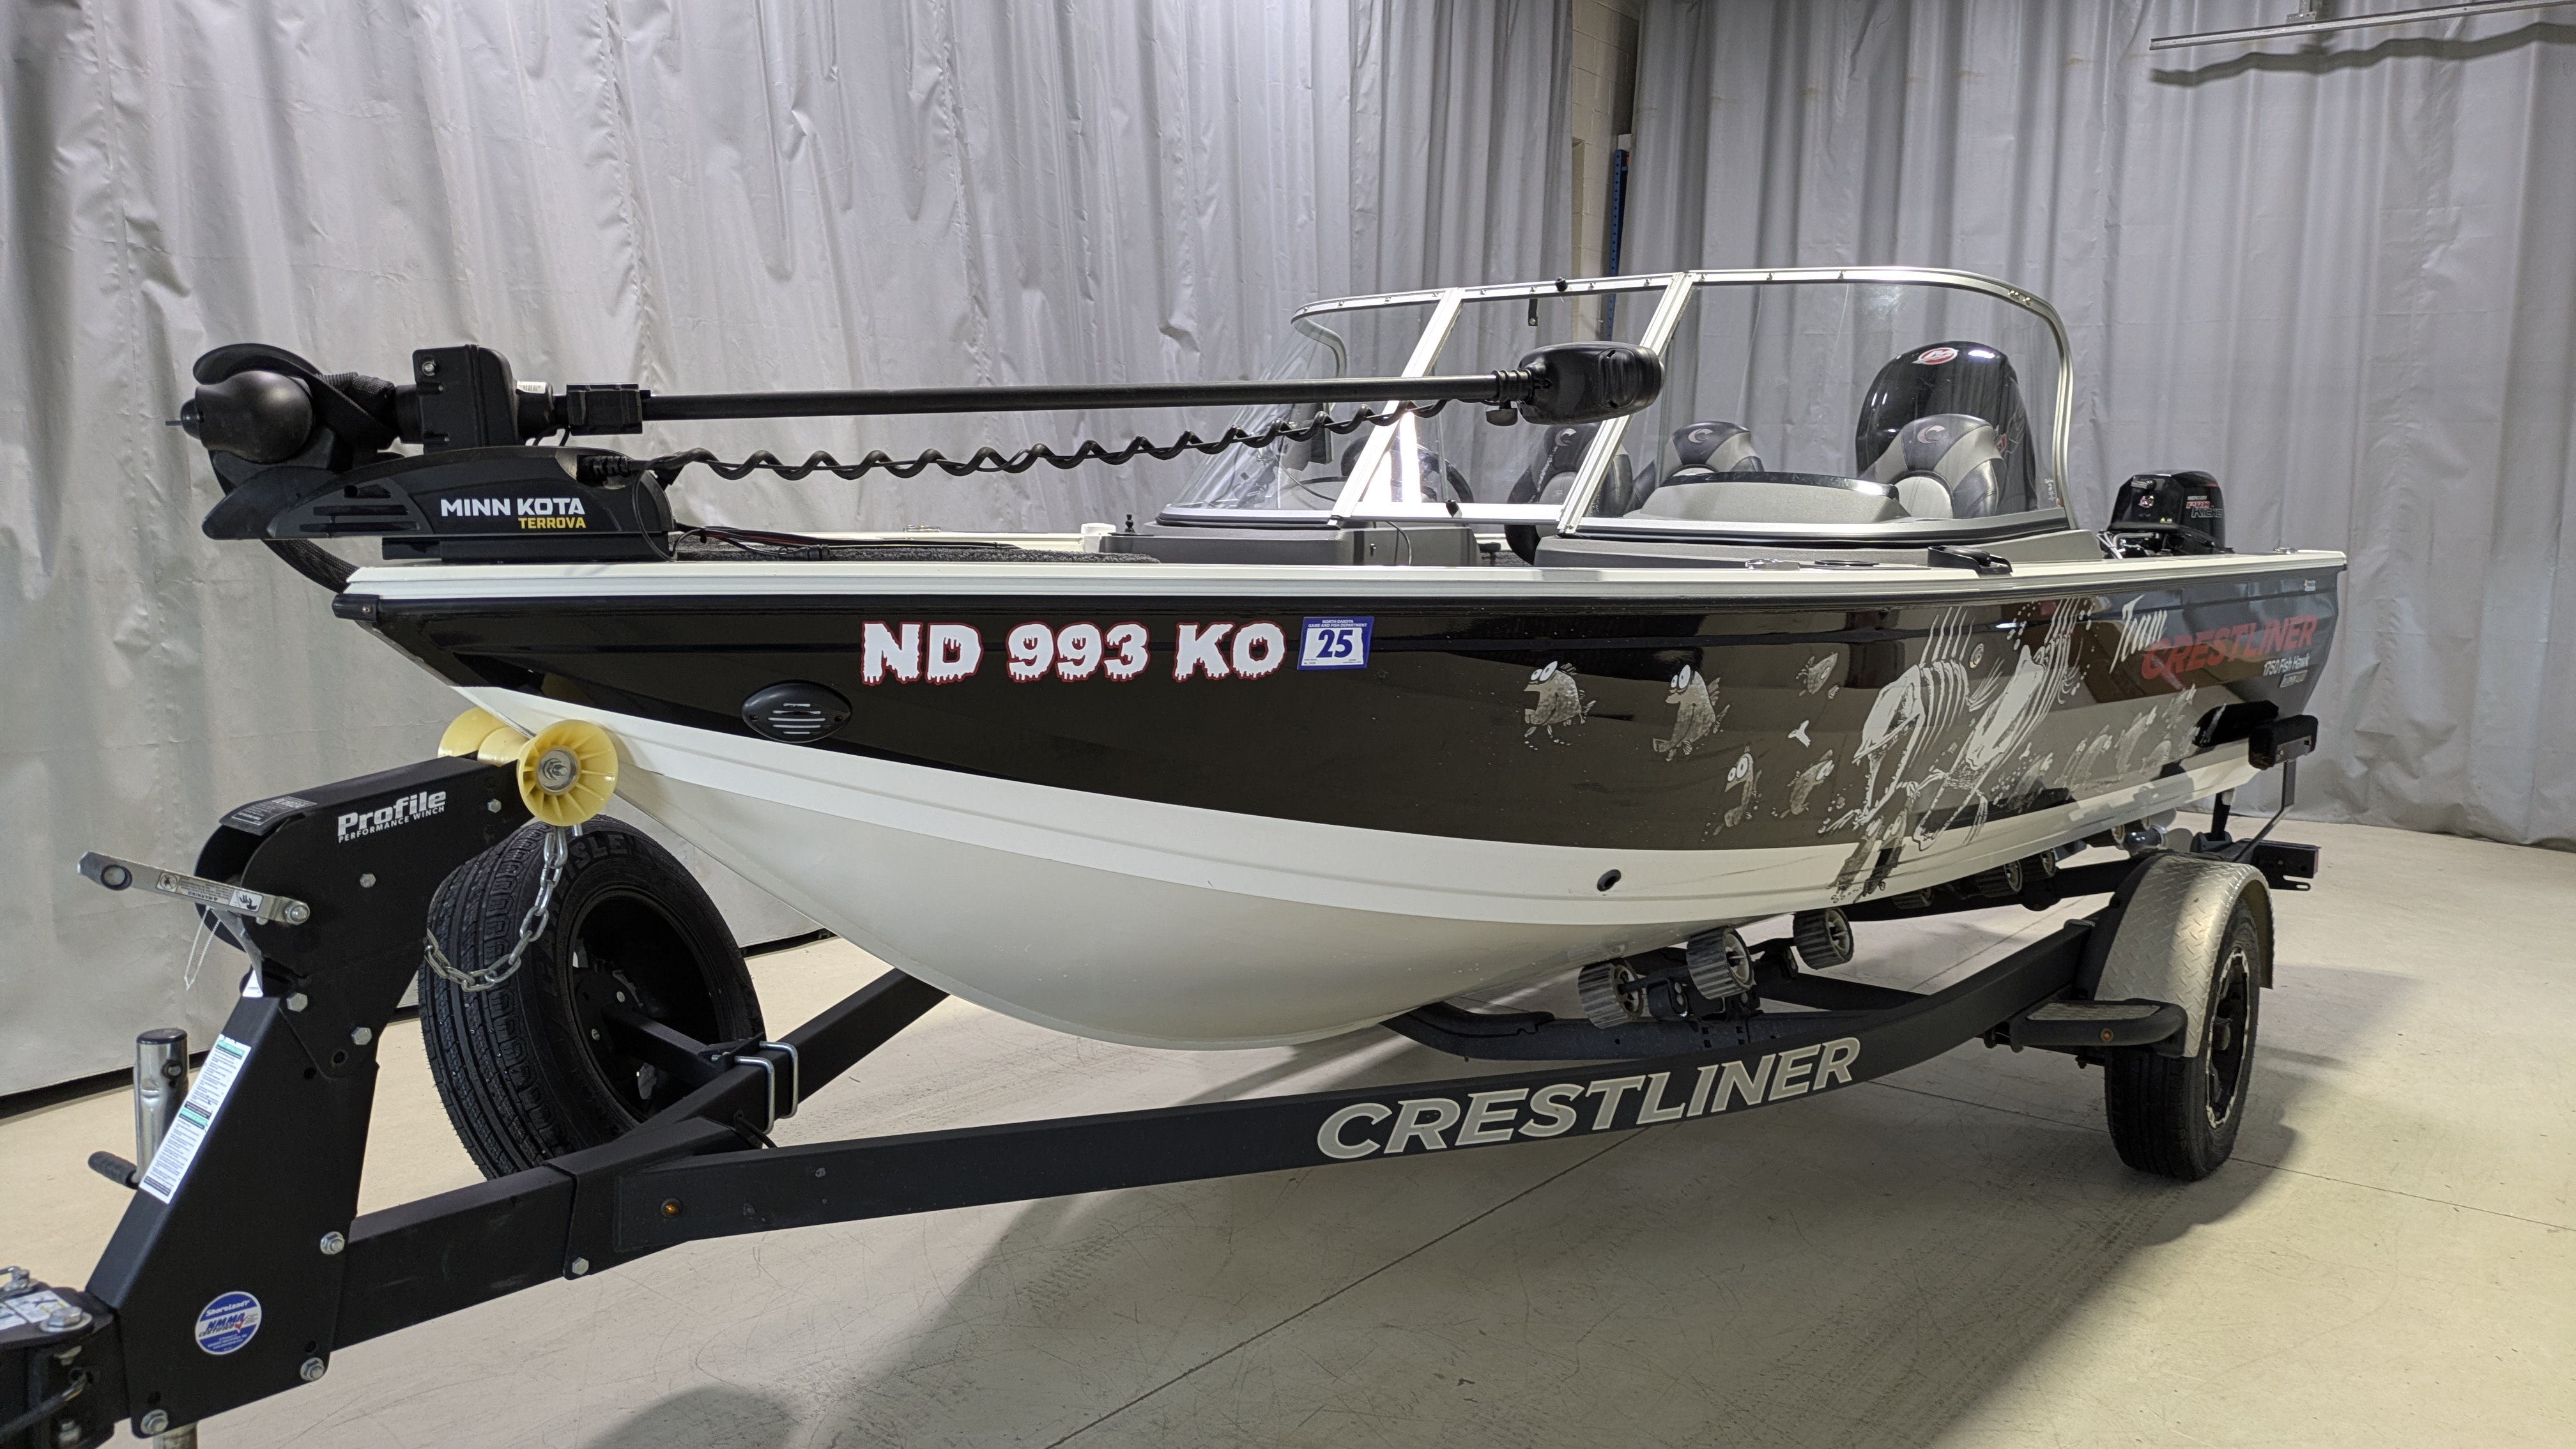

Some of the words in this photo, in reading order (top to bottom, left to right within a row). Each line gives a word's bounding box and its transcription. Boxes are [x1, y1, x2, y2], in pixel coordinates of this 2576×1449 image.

[441, 498, 511, 516] MINN
[517, 498, 586, 516] KOTA
[518, 517, 586, 529] TERROVA
[861, 621, 985, 686] ND
[1006, 622, 1150, 683] 993
[1174, 621, 1287, 684] KO
[1315, 629, 1353, 658] 25
[2142, 615, 2318, 680] CRESTLINER
[2262, 659, 2280, 677] 1750
[2278, 657, 2292, 674] Fish
[2292, 653, 2310, 670] Hawk
[337, 791, 447, 837] Profile
[338, 816, 410, 843] PERFORMANCE
[413, 805, 445, 820] WINCH
[1316, 1036, 1861, 1160] CRESTLINER
